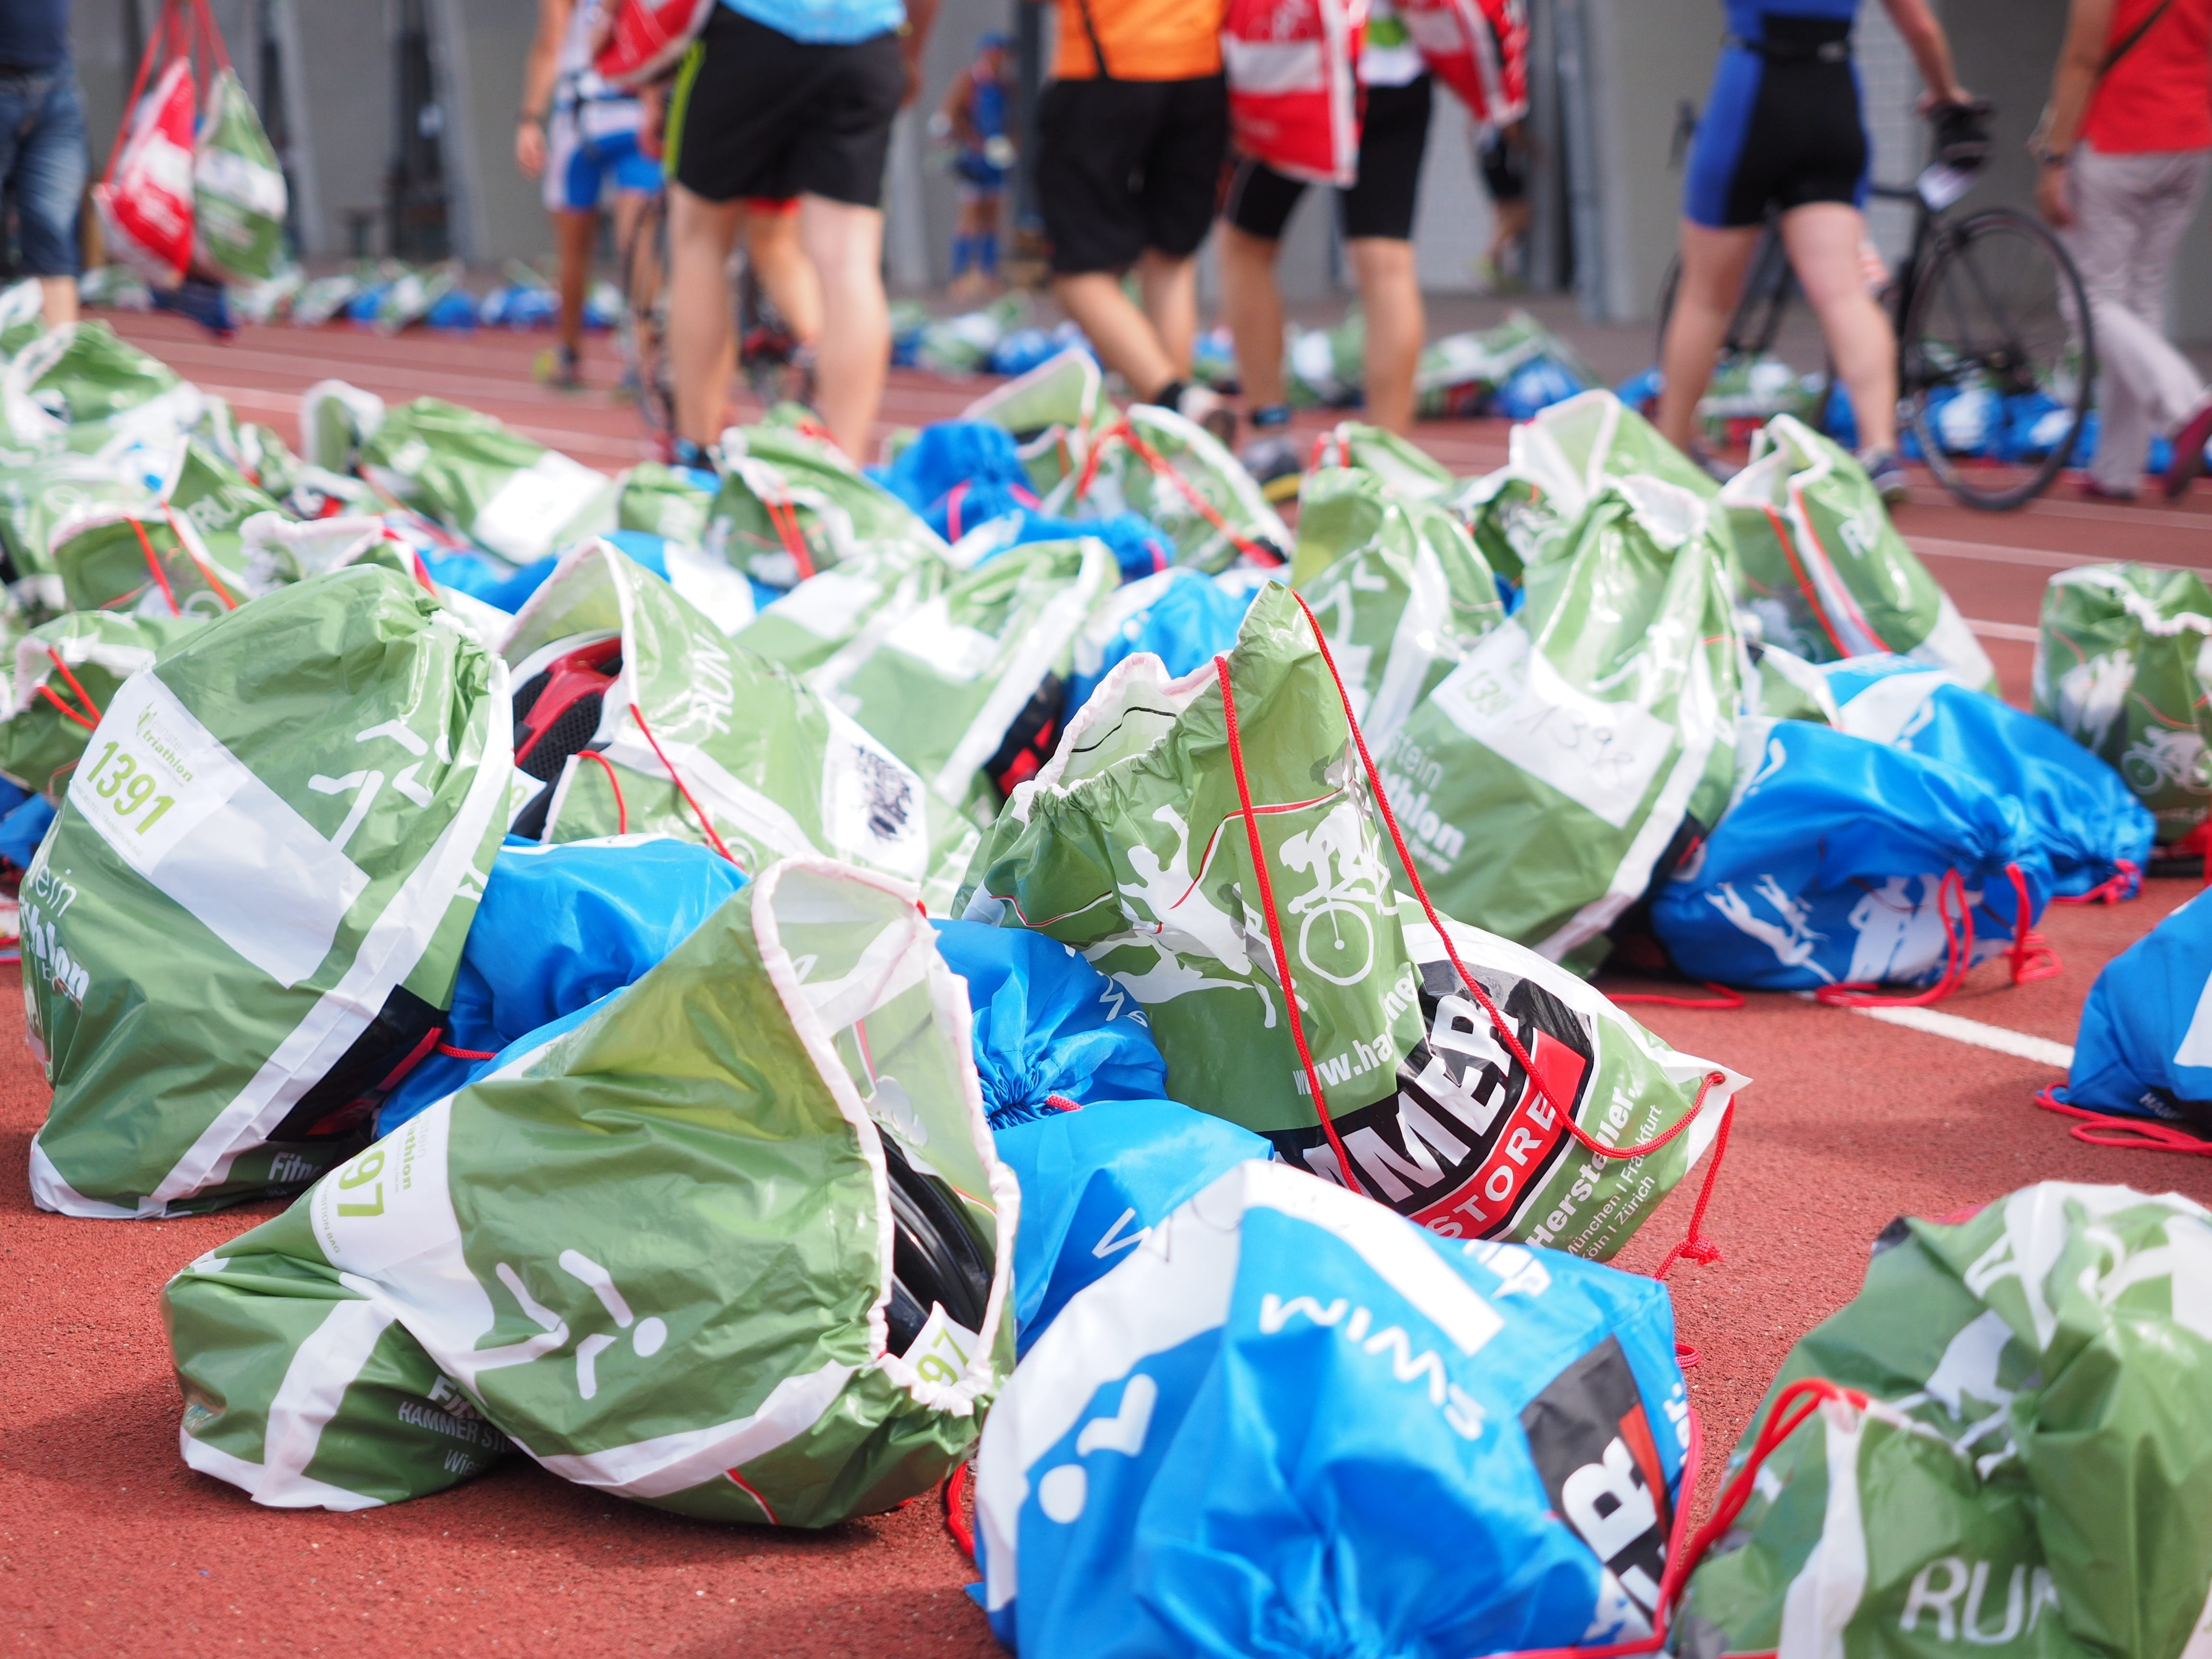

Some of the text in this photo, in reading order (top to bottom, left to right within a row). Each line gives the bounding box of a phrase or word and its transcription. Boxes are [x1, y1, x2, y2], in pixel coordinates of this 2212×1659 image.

[143, 730, 193, 782] triathlon
[87, 741, 175, 835] 1391
[1621, 1105, 1662, 1184] Frakfurt
[338, 1132, 391, 1217] 97
[1614, 1175, 1656, 1226] Zürich
[326, 1232, 341, 1253] BAG
[916, 1328, 970, 1387] 97
[398, 1401, 479, 1444] HAMMER
